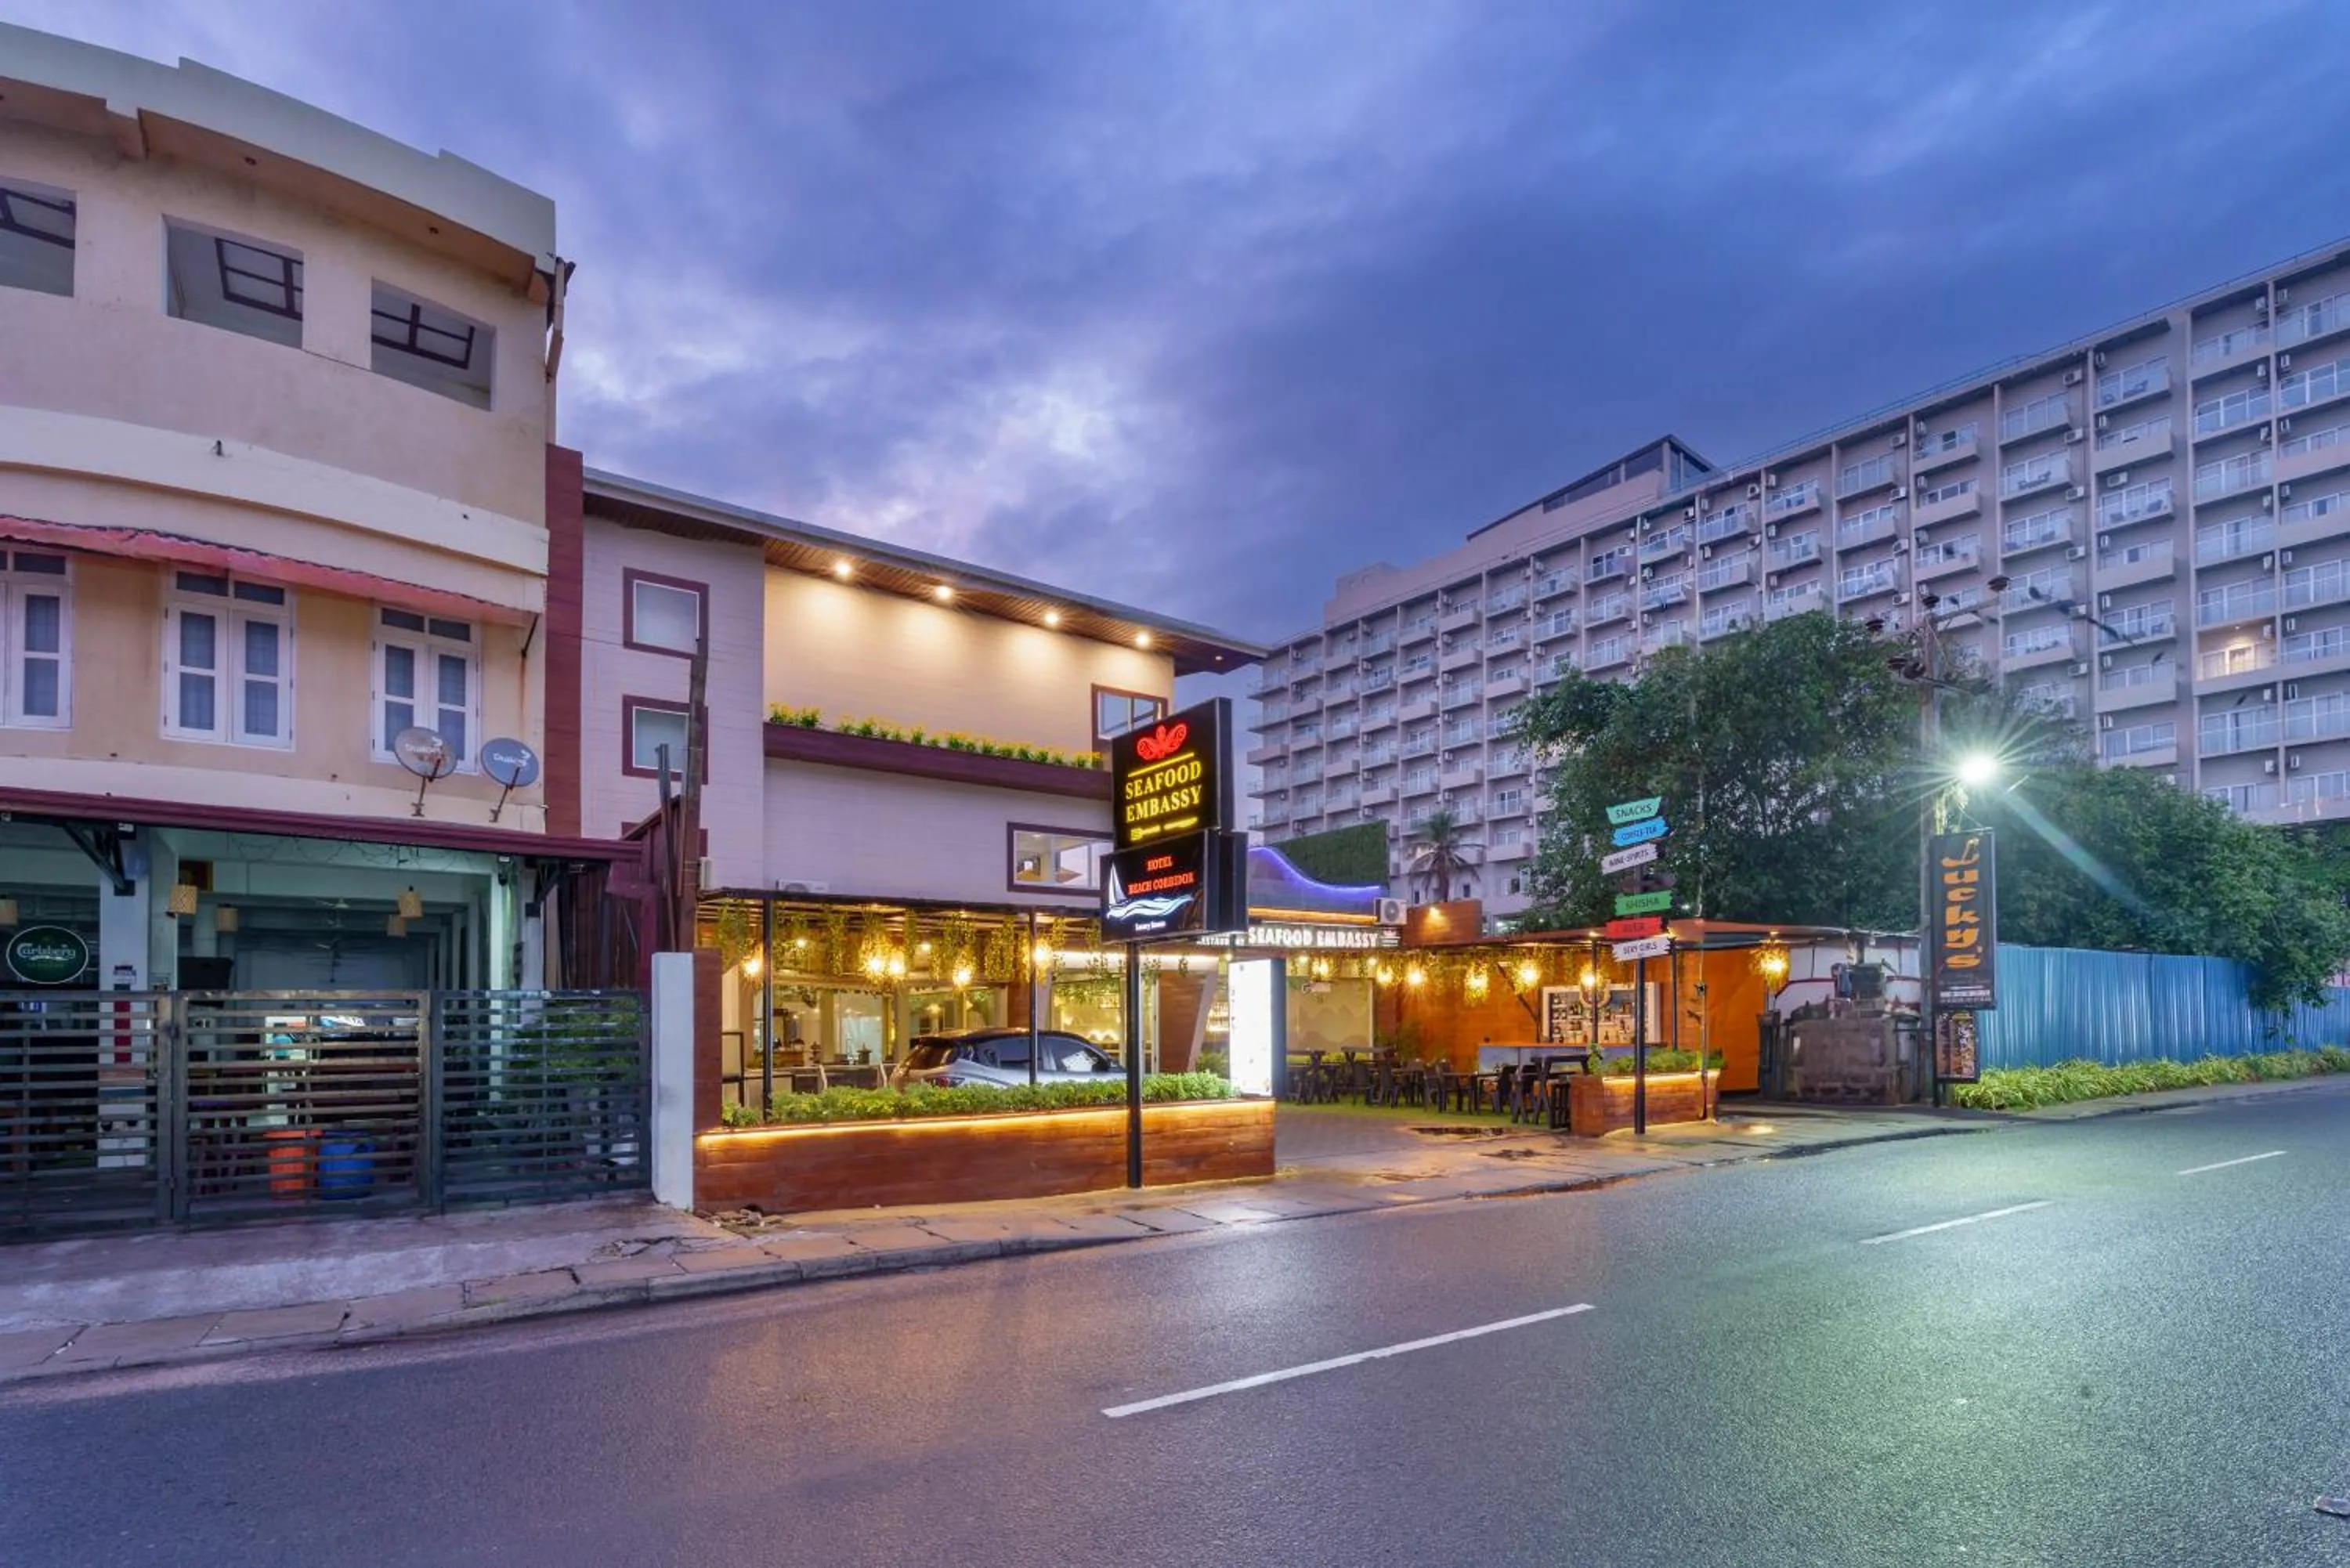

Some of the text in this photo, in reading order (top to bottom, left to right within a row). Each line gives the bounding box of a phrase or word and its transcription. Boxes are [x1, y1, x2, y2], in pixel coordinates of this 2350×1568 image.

[1126, 761, 1202, 800] SEAFOOD
[1126, 784, 1202, 823] EMBASSY
[1616, 804, 1652, 818] SNACKS
[1147, 856, 1173, 872] HOTEL
[1128, 873, 1195, 894] BEACH CORRIDOR
[1248, 927, 1312, 946] SEAFOOD
[1317, 930, 1378, 948] EMBASSY
[16, 943, 76, 959] Carlsberg
